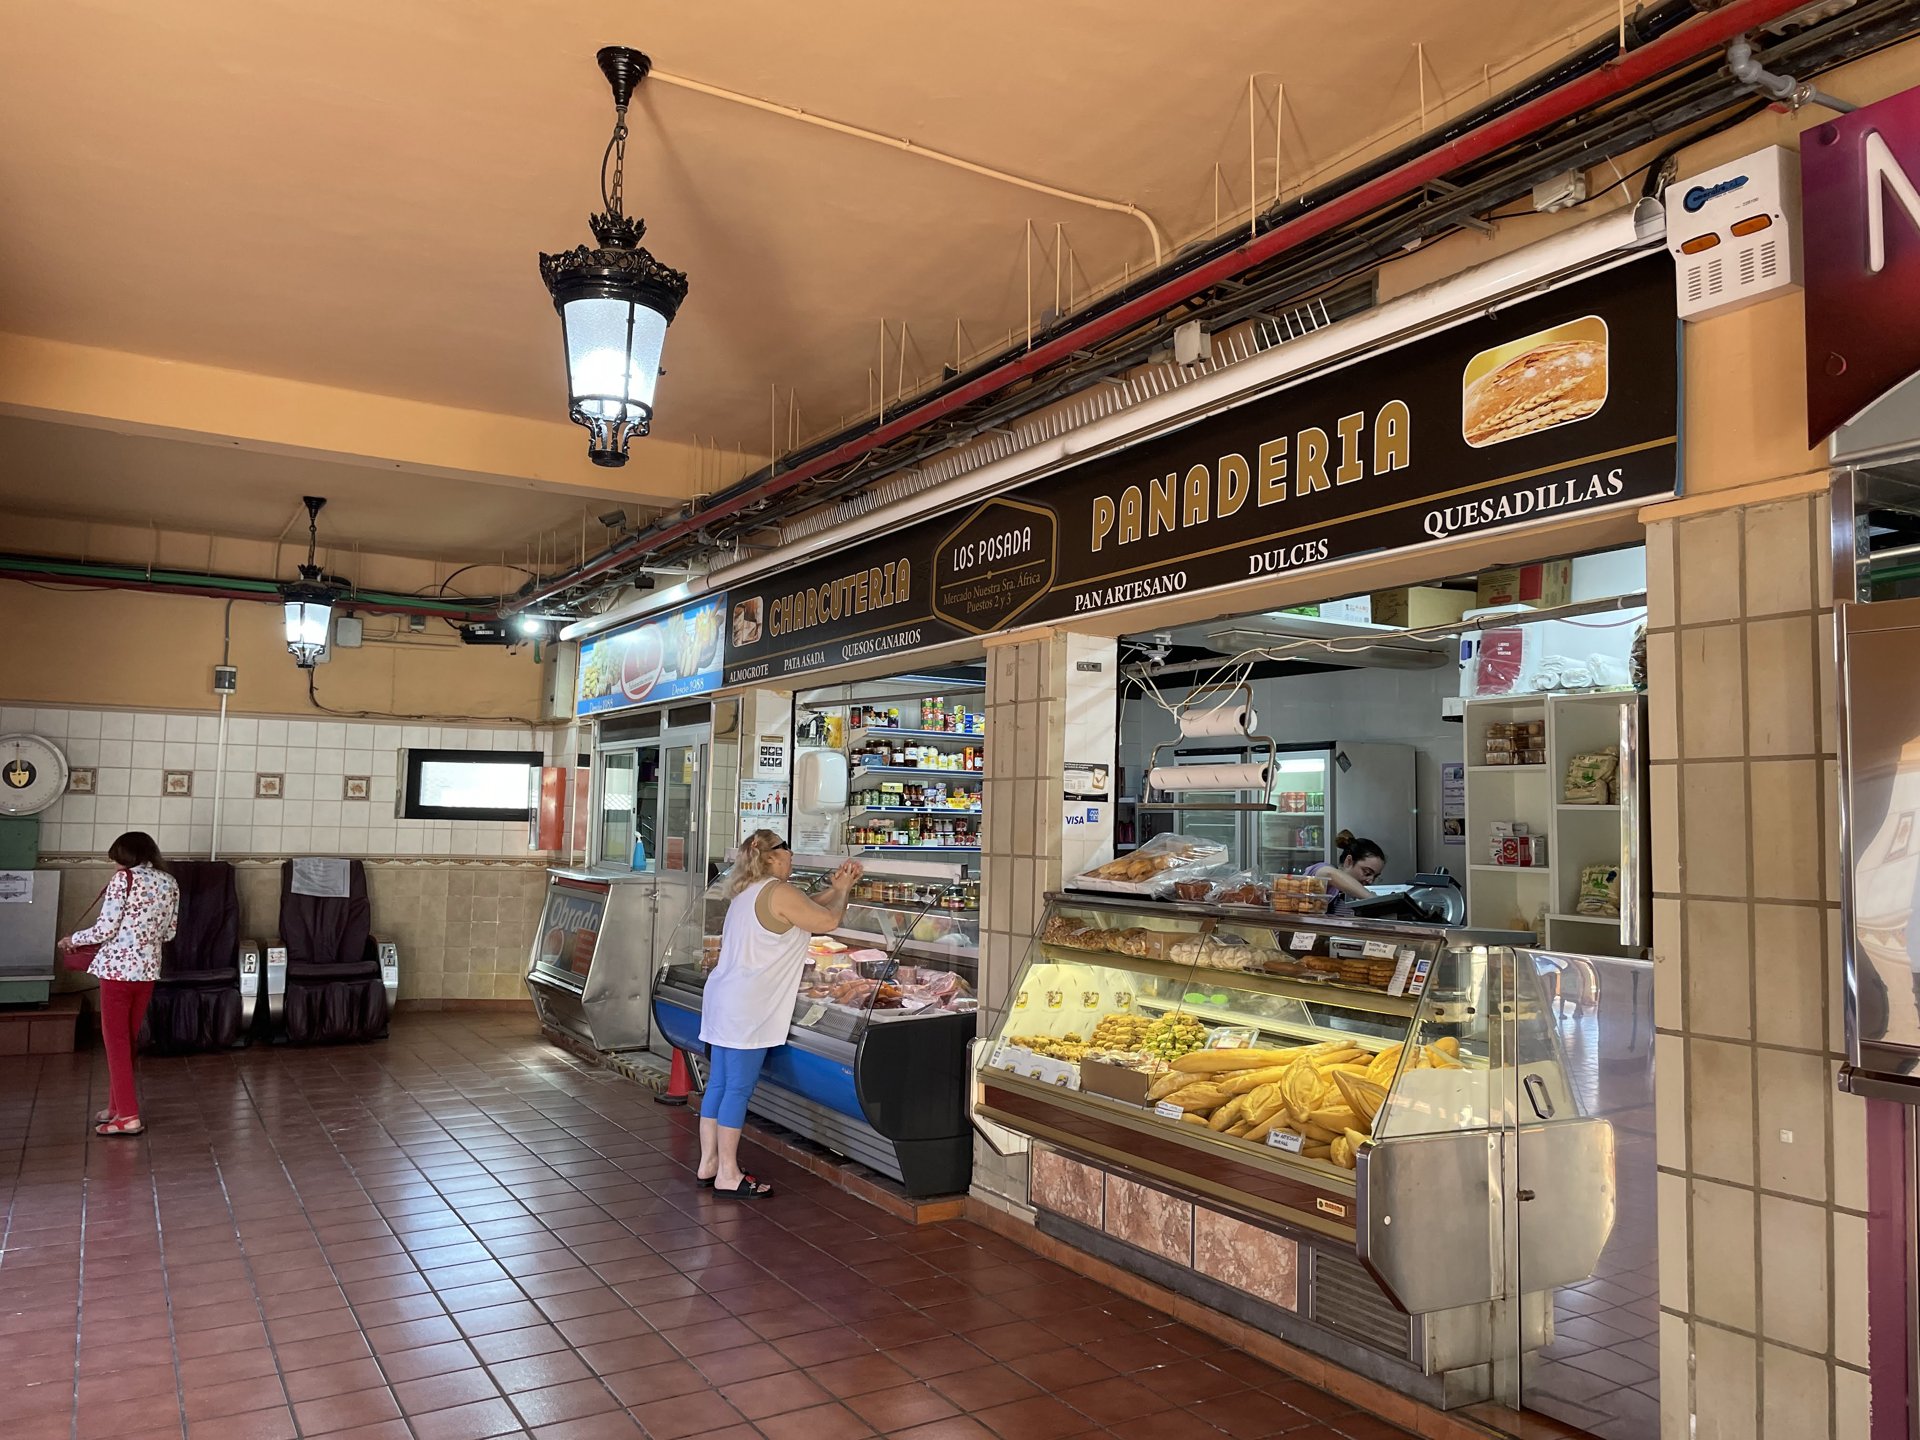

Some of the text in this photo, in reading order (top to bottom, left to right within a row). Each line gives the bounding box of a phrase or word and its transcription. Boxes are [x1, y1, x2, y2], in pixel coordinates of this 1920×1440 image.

[1092, 400, 1410, 552] PANADERIA
[1424, 468, 1624, 538] QUESADILLAS
[953, 526, 1031, 571] LOS POSADA
[1249, 538, 1329, 575] DULCES
[769, 557, 911, 637] CHARCUTERIA
[943, 588, 972, 605] Mercado
[973, 583, 1000, 599] Nuestra
[1002, 578, 1016, 591] Sra.
[966, 597, 993, 613] Puestos
[994, 595, 999, 607] 2
[1006, 593, 1011, 605] 3
[1075, 571, 1187, 611] PAN ARTESANO
[784, 651, 825, 671] PATA ASADA
[841, 629, 921, 661] QUESOS CANARIOS
[671, 682, 689, 696] Desde
[729, 663, 769, 683] ALMOGROTE
[1065, 815, 1084, 825] VISA
